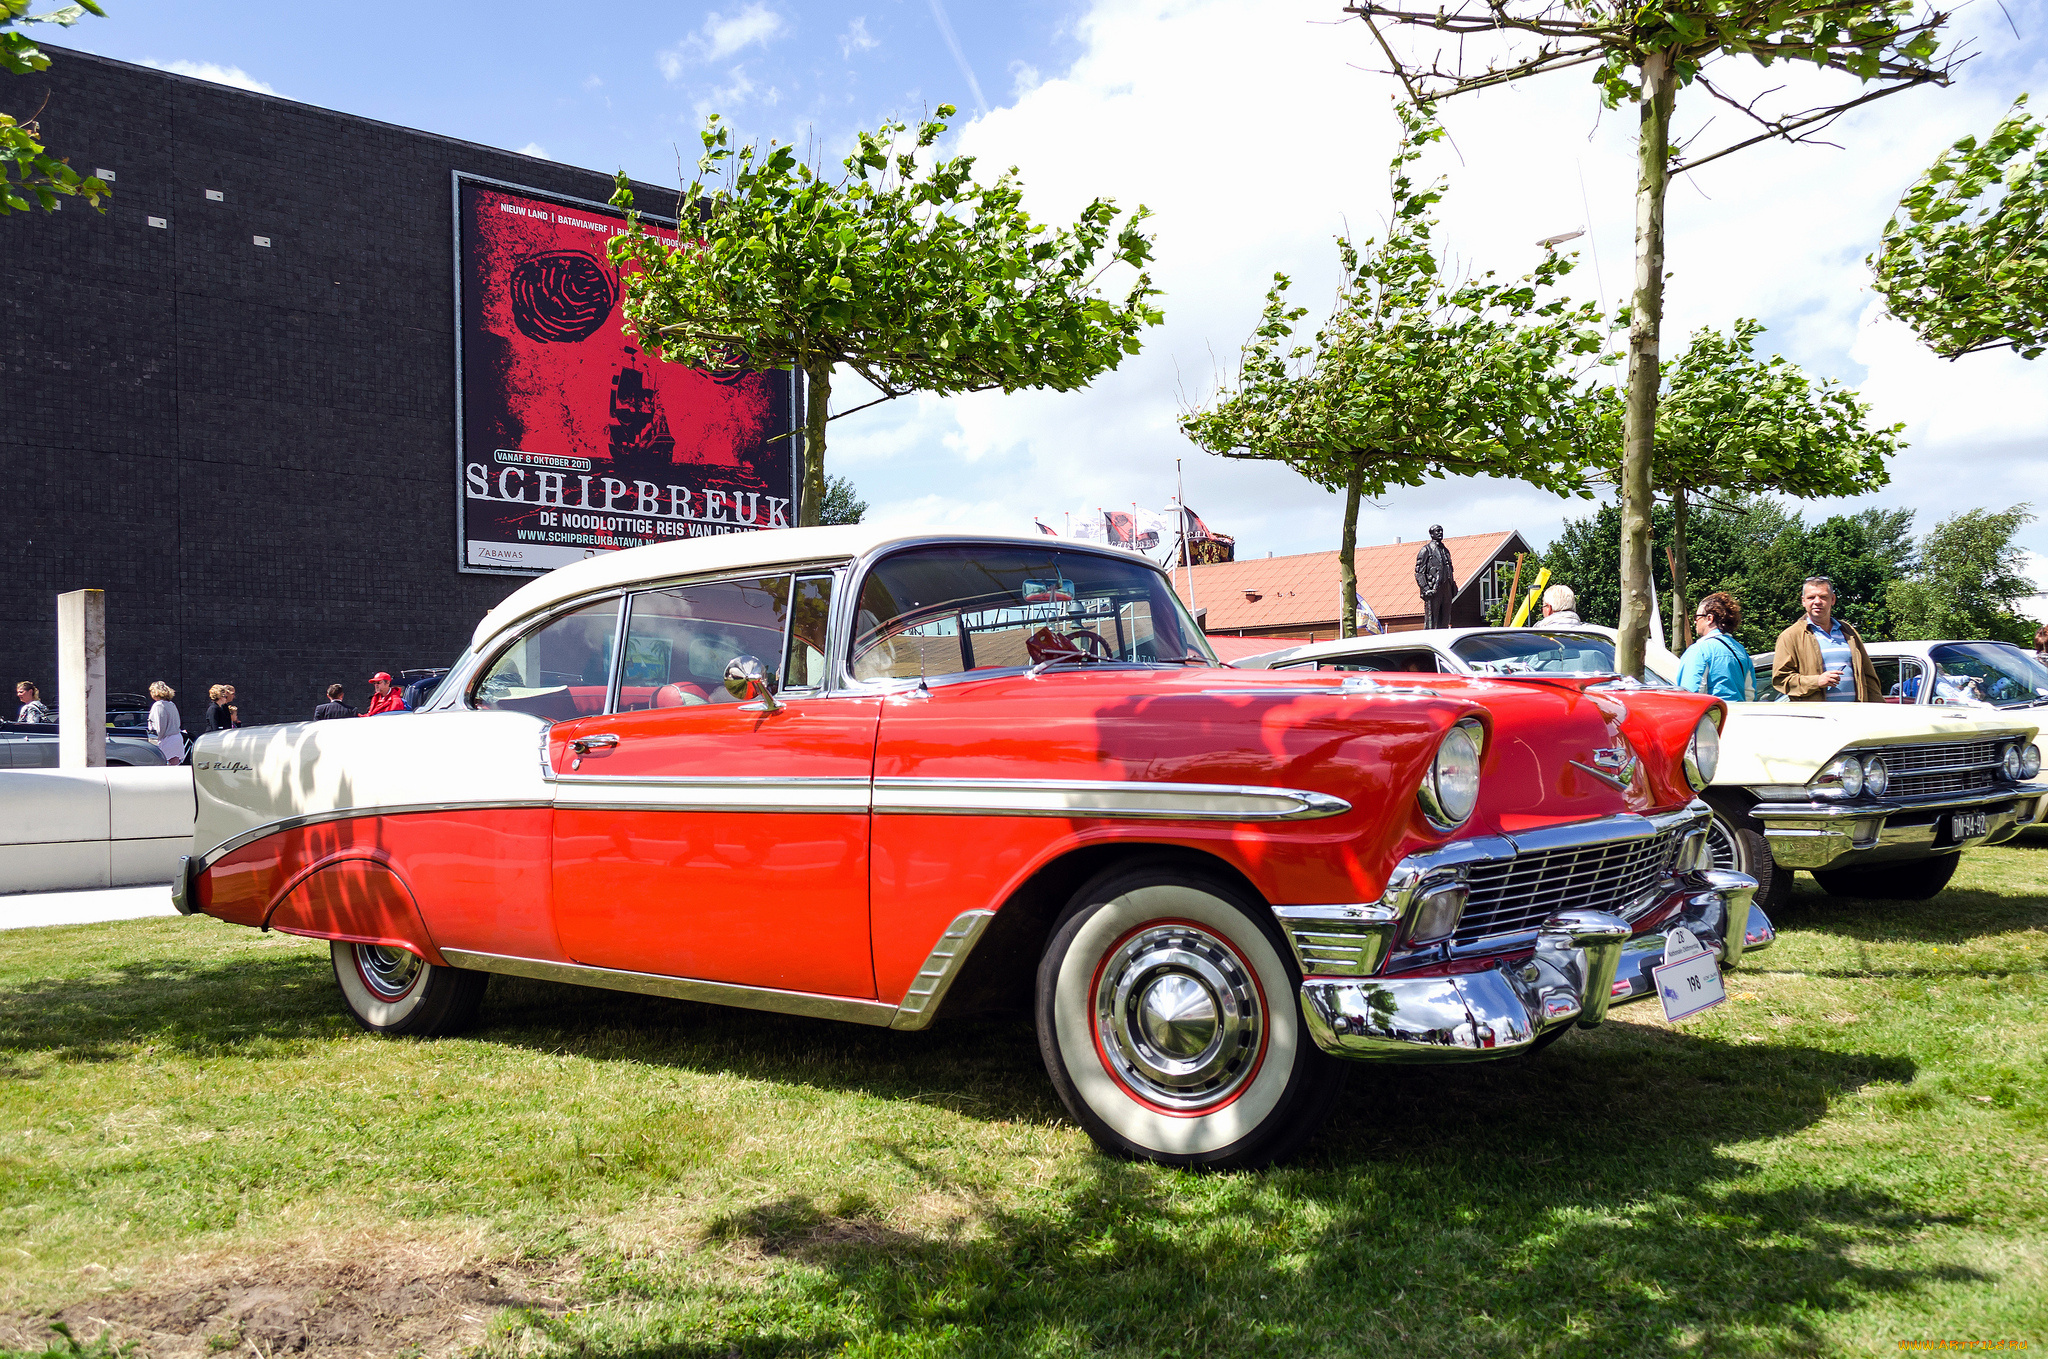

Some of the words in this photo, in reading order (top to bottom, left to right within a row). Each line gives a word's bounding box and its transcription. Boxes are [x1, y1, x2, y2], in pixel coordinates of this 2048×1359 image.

[500, 203, 526, 216] NIEUW
[528, 209, 548, 221] LAND
[558, 215, 608, 233] BATAVIAWERF
[497, 452, 523, 462] VANAF
[533, 457, 569, 467] OKTOBER
[571, 460, 589, 469] 2011
[466, 462, 790, 529] SCHIPBREUK
[540, 511, 558, 526] DE
[562, 513, 652, 534] NOODLOTTIGE
[656, 520, 685, 536] REIS
[687, 523, 712, 537] VAN
[478, 547, 523, 559] ZABAWAS
[1687, 975, 1701, 992] 198
